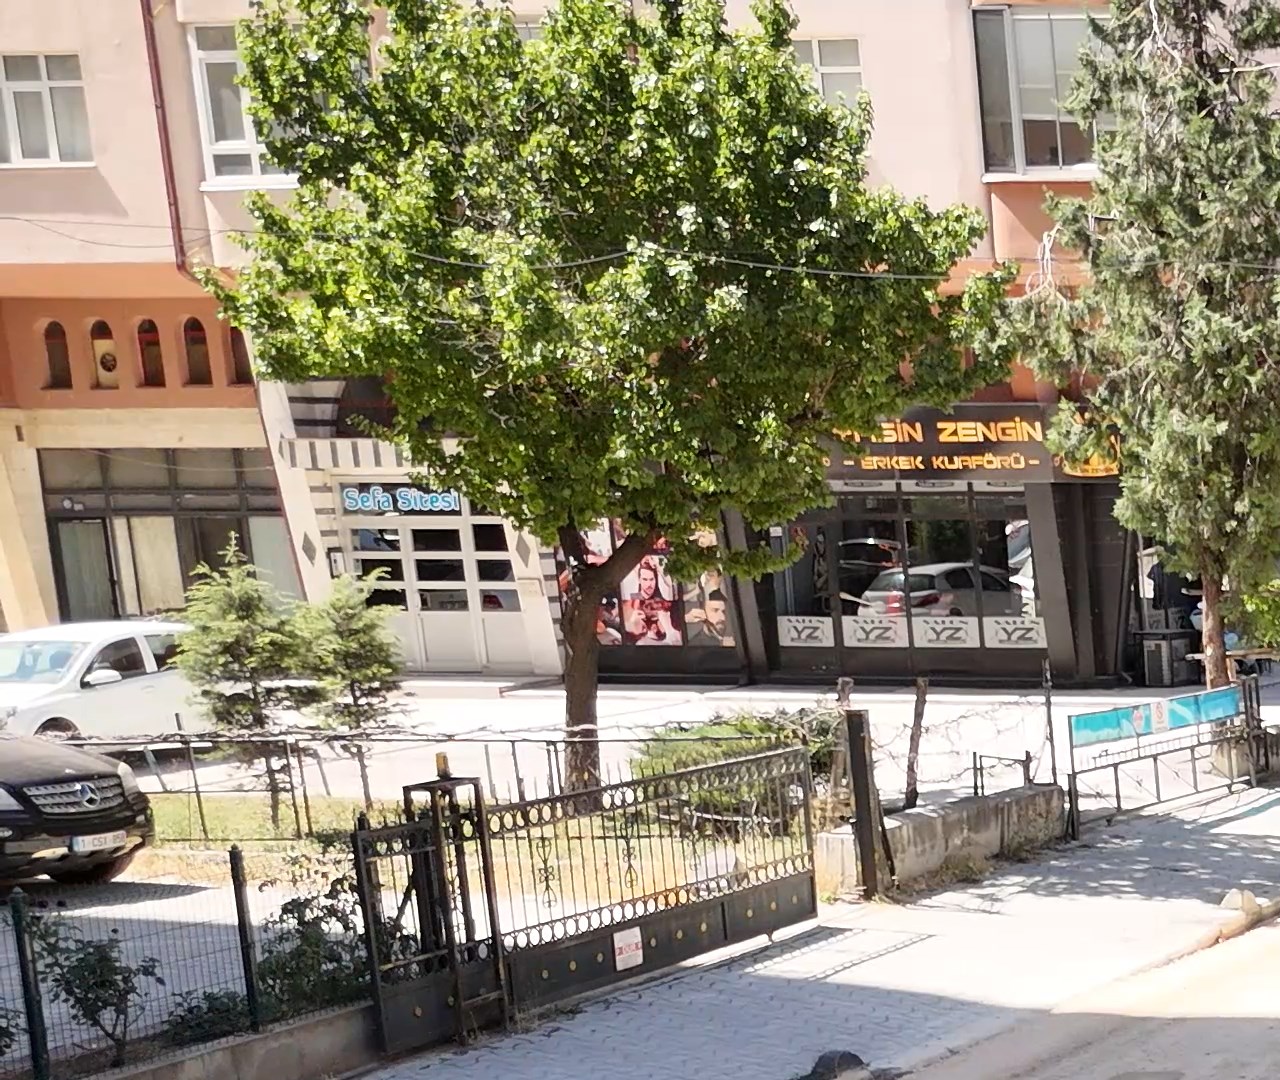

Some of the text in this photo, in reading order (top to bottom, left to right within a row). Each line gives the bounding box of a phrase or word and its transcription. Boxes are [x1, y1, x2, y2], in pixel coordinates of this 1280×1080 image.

[936, 416, 1043, 443] ZENGİN
[861, 453, 1025, 470] ERKEK KUAFÖRÜ
[343, 485, 460, 512] Sefa Sitesi
[793, 626, 821, 639] YZ
[860, 626, 893, 640] YZ
[929, 626, 963, 640] YZ
[1000, 627, 1035, 641] YZ
